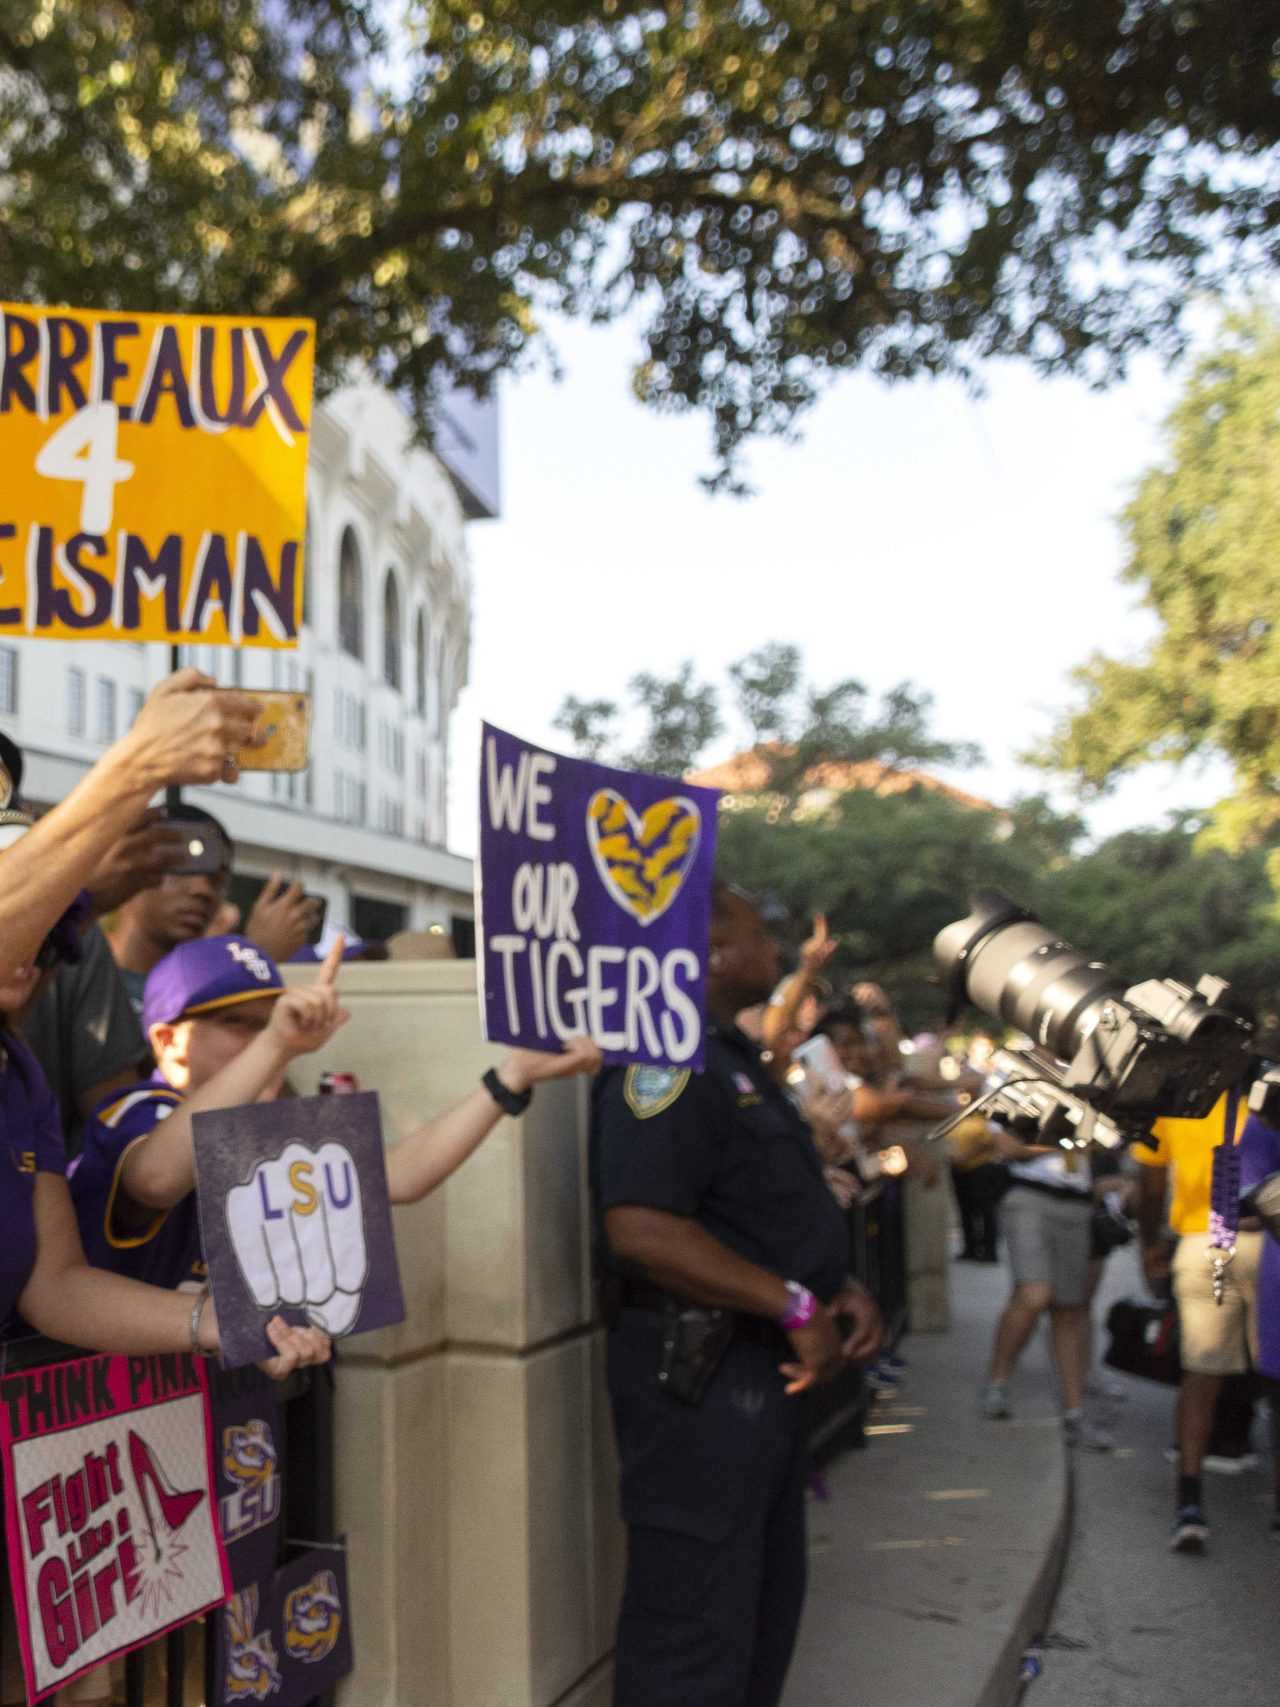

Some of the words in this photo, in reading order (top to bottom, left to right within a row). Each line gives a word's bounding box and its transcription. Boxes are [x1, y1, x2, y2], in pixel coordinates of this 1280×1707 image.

[34, 399, 135, 535] 4
[485, 734, 558, 842] WE
[511, 861, 581, 942] OUR
[489, 934, 702, 1064] TIGERS
[258, 1160, 353, 1221] LSU
[0, 1355, 116, 1438] THINK
[128, 1351, 202, 1405] PINK
[21, 1439, 124, 1560] Fight
